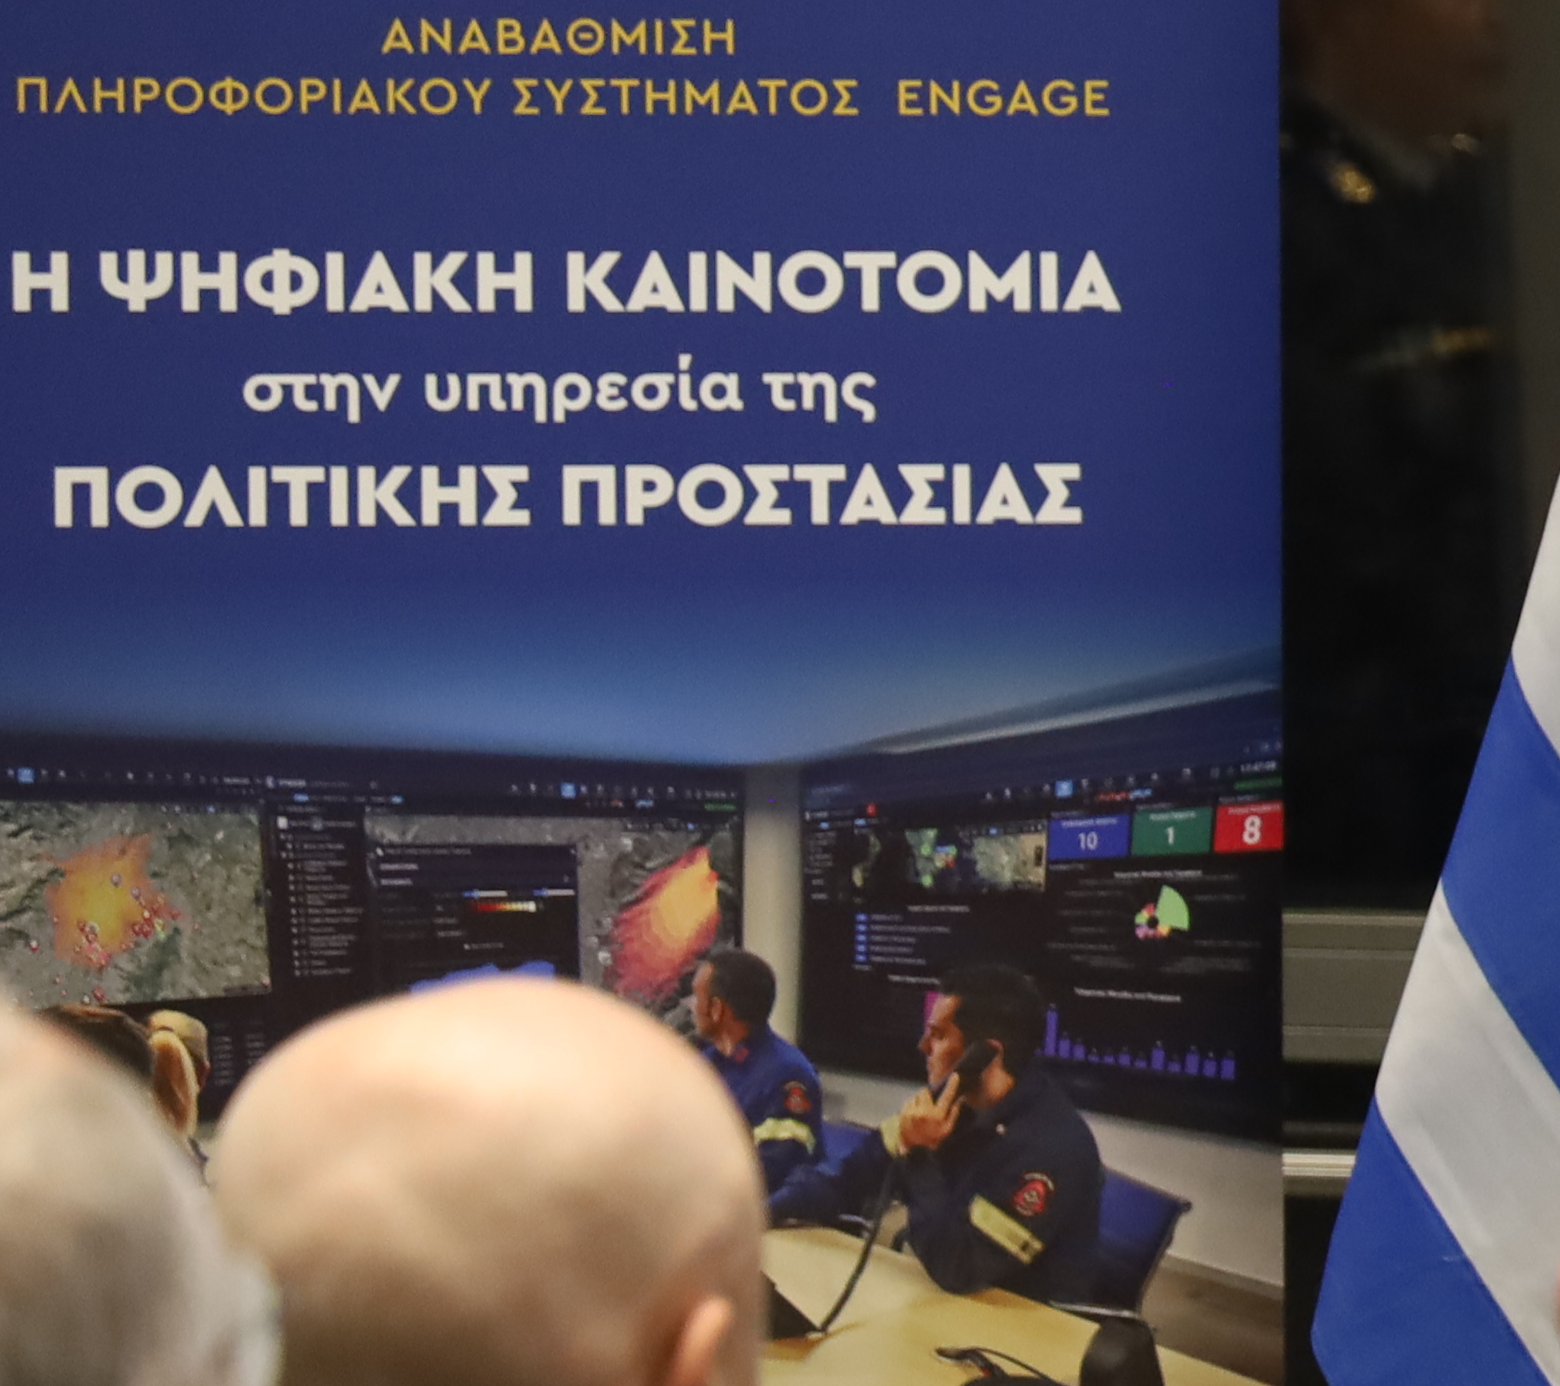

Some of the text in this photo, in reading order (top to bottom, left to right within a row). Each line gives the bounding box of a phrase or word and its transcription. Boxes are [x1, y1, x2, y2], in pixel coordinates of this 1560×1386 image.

[382, 18, 735, 56] ΑΝΑΒΑΘΜΙΣΗ
[17, 76, 1110, 117] ΠΛΗΡΟΦΟΡΙΑΚΟΥ ΣΥΣΤΗΜΑΤΟΣ ENGAGE
[12, 248, 1121, 315] Η ΨΗΦΙΑΚΗ ΚΑΙΝΟΤΟΜΙΑ
[242, 353, 877, 424] στην υπηρεσία της
[54, 462, 1083, 529] ΠΟΛΙΤΙΚΗΣ ΠΡΟΣΤΑΣΙΑΣ
[1242, 815, 1263, 845] 8
